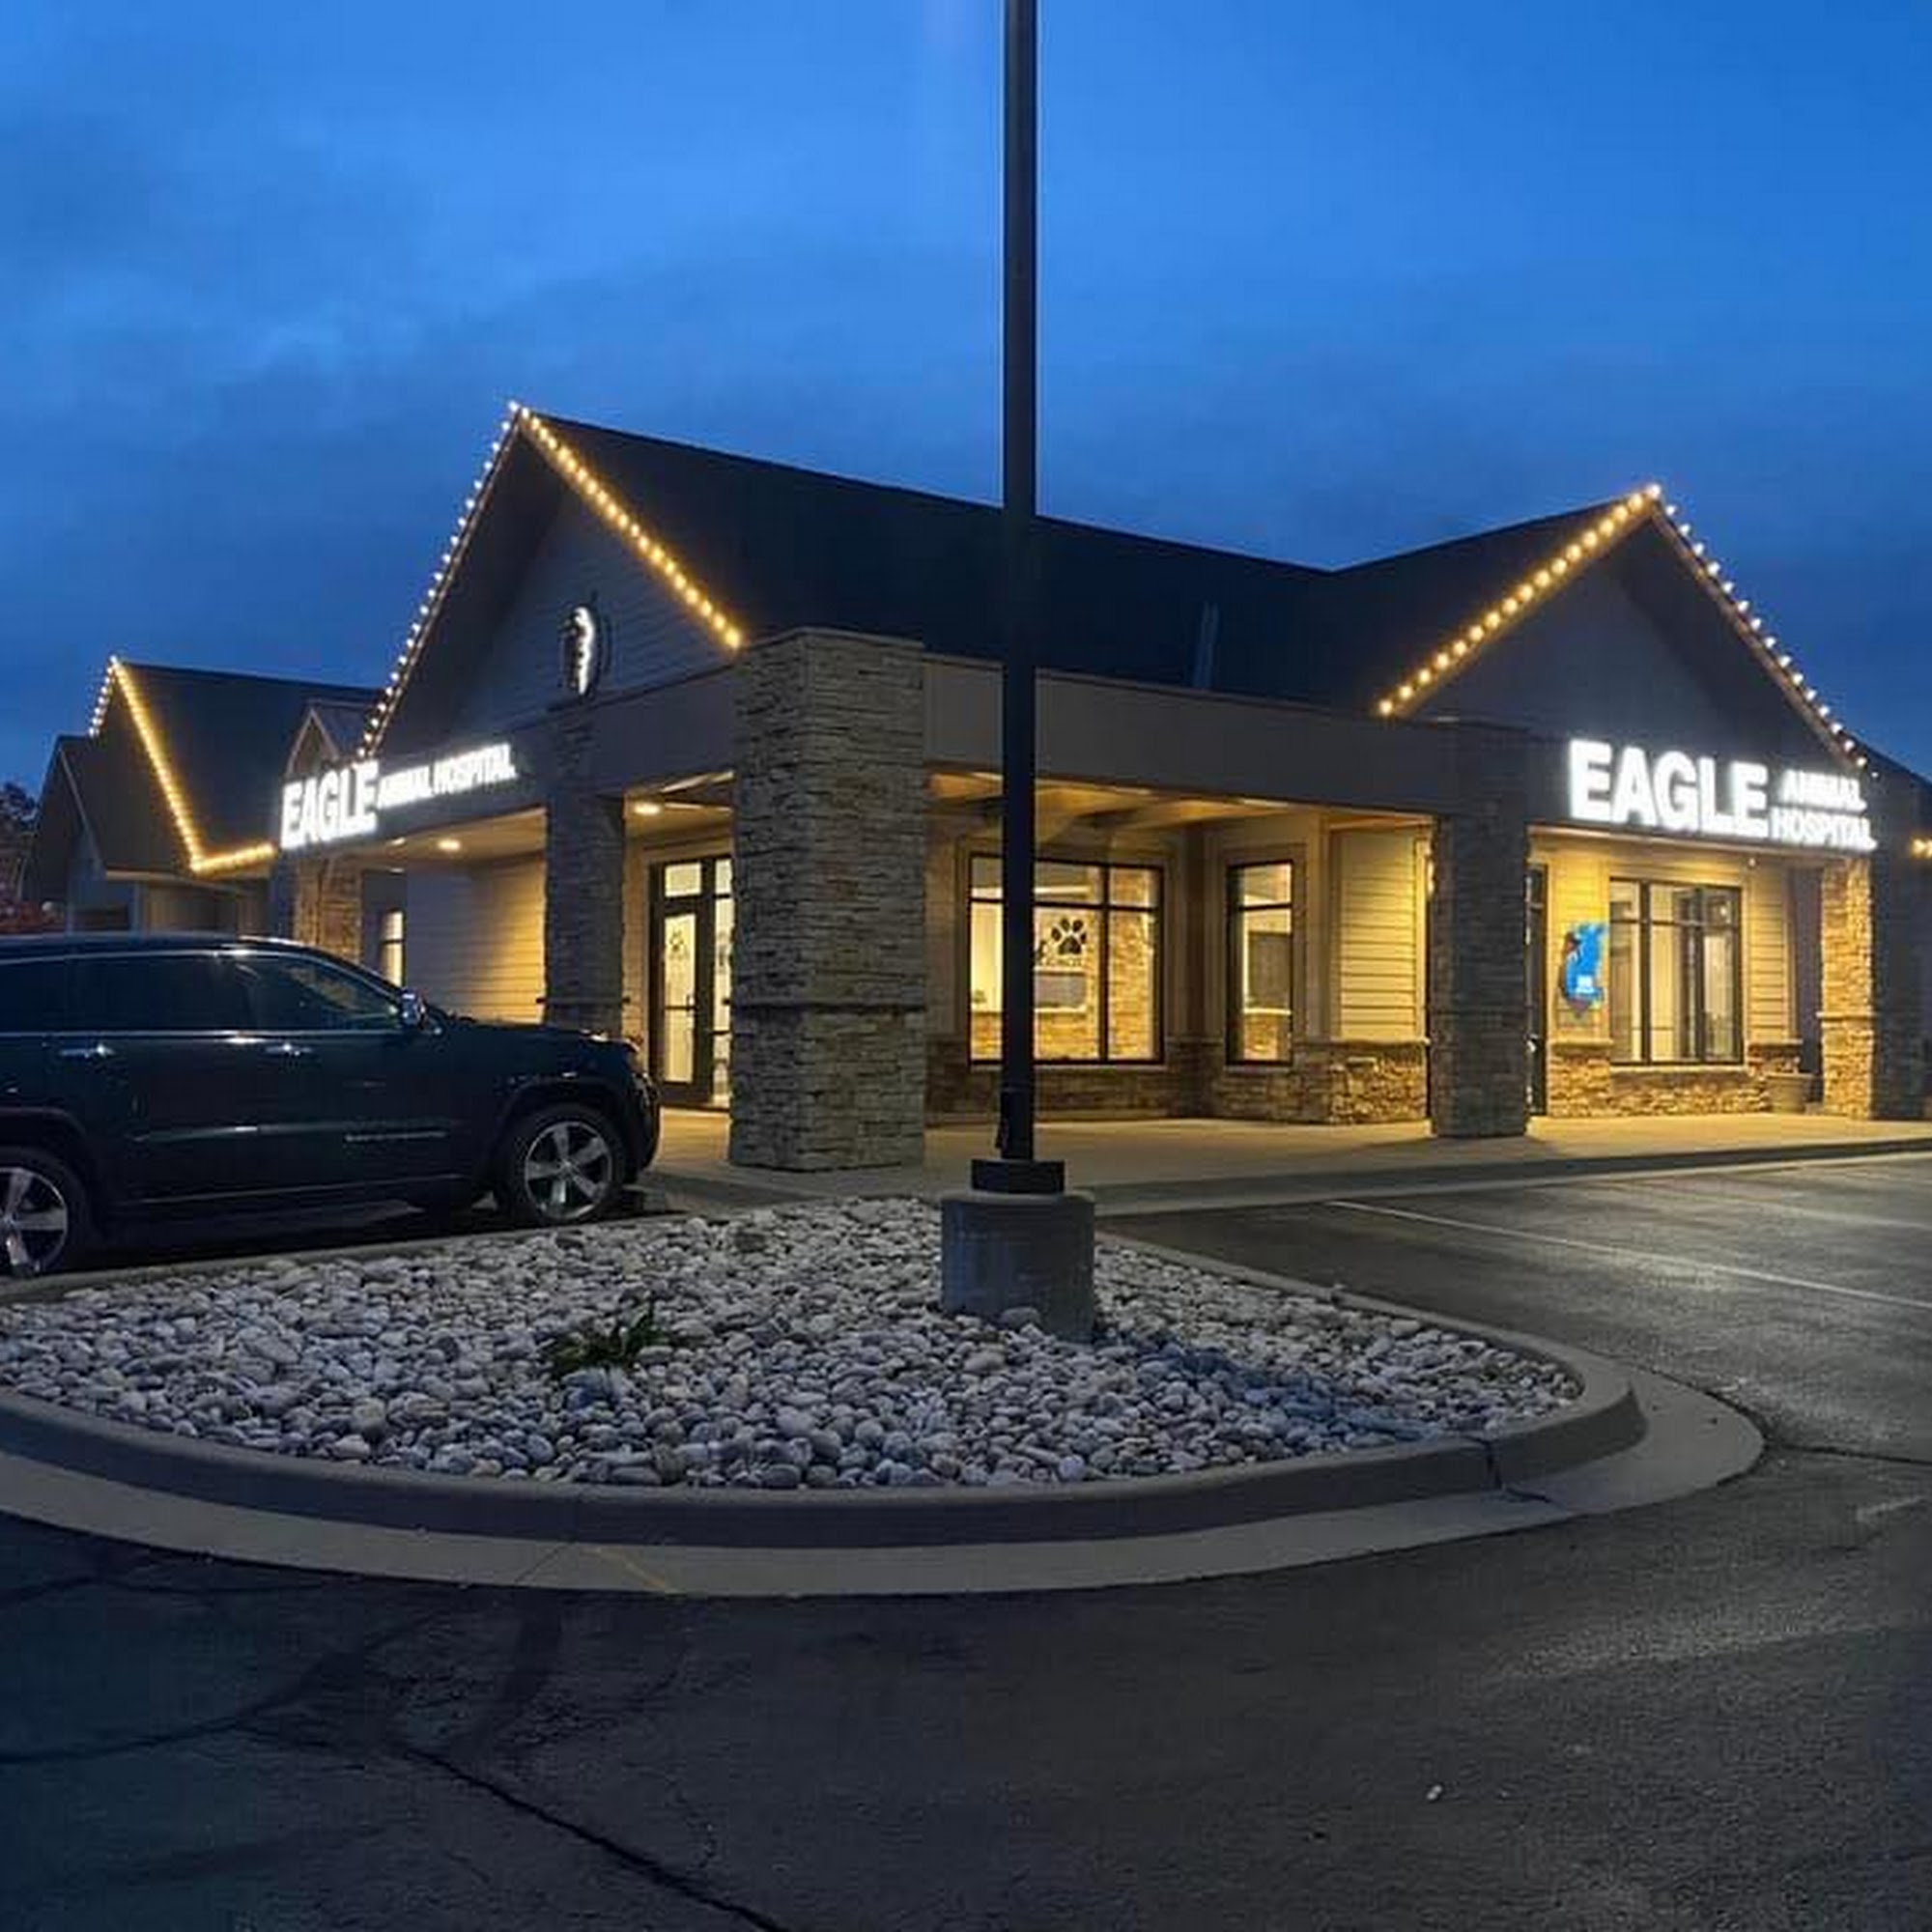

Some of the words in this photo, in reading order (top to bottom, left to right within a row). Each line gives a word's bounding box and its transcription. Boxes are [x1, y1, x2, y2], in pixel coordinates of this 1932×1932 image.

[280, 759, 380, 850] EAGLE
[434, 743, 518, 796] HOSPITAL
[1569, 738, 1770, 838] EAGLE
[1770, 807, 1877, 852] HOSPITAL
